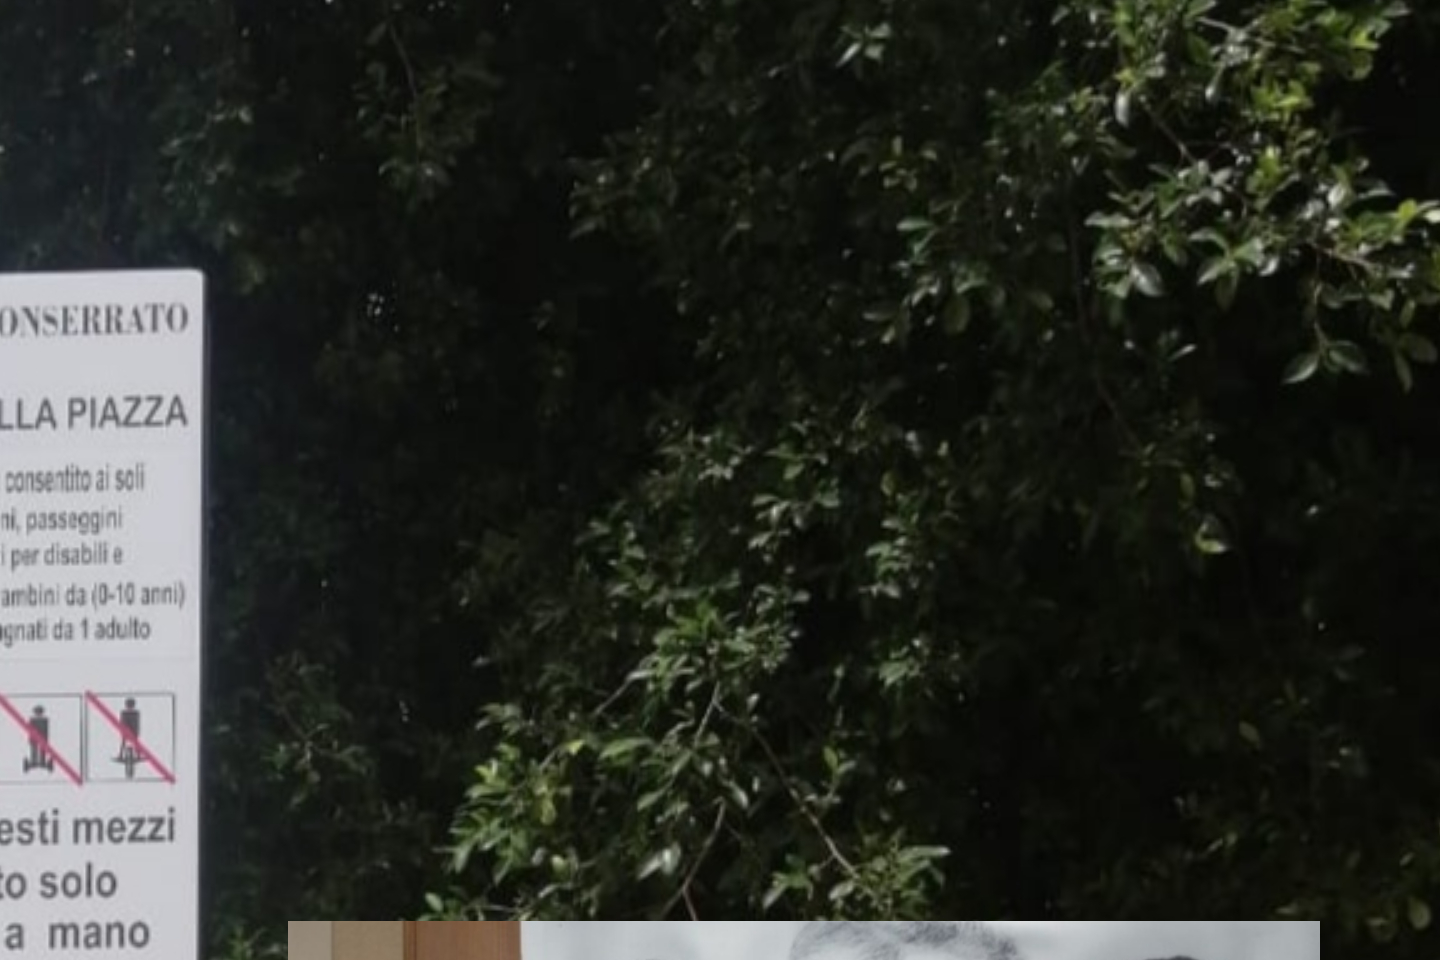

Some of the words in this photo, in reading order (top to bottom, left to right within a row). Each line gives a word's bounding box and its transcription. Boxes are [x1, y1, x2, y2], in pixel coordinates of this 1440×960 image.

[68, 394, 188, 430] PIAZZA
[6, 464, 91, 493] consentito
[96, 464, 109, 492] ai
[115, 463, 144, 492] soli
[26, 508, 122, 535] passeggini
[11, 549, 40, 572] per
[44, 542, 108, 565] disabili
[113, 547, 123, 565] e
[65, 584, 87, 607] da
[91, 582, 135, 610] (0-10
[141, 582, 185, 609] anni)
[53, 622, 74, 640] da
[81, 621, 88, 639] 1
[94, 619, 151, 640] adulto
[73, 806, 176, 845] mezzi
[40, 861, 118, 900] solo
[4, 923, 24, 951] a
[49, 920, 150, 950] mano
